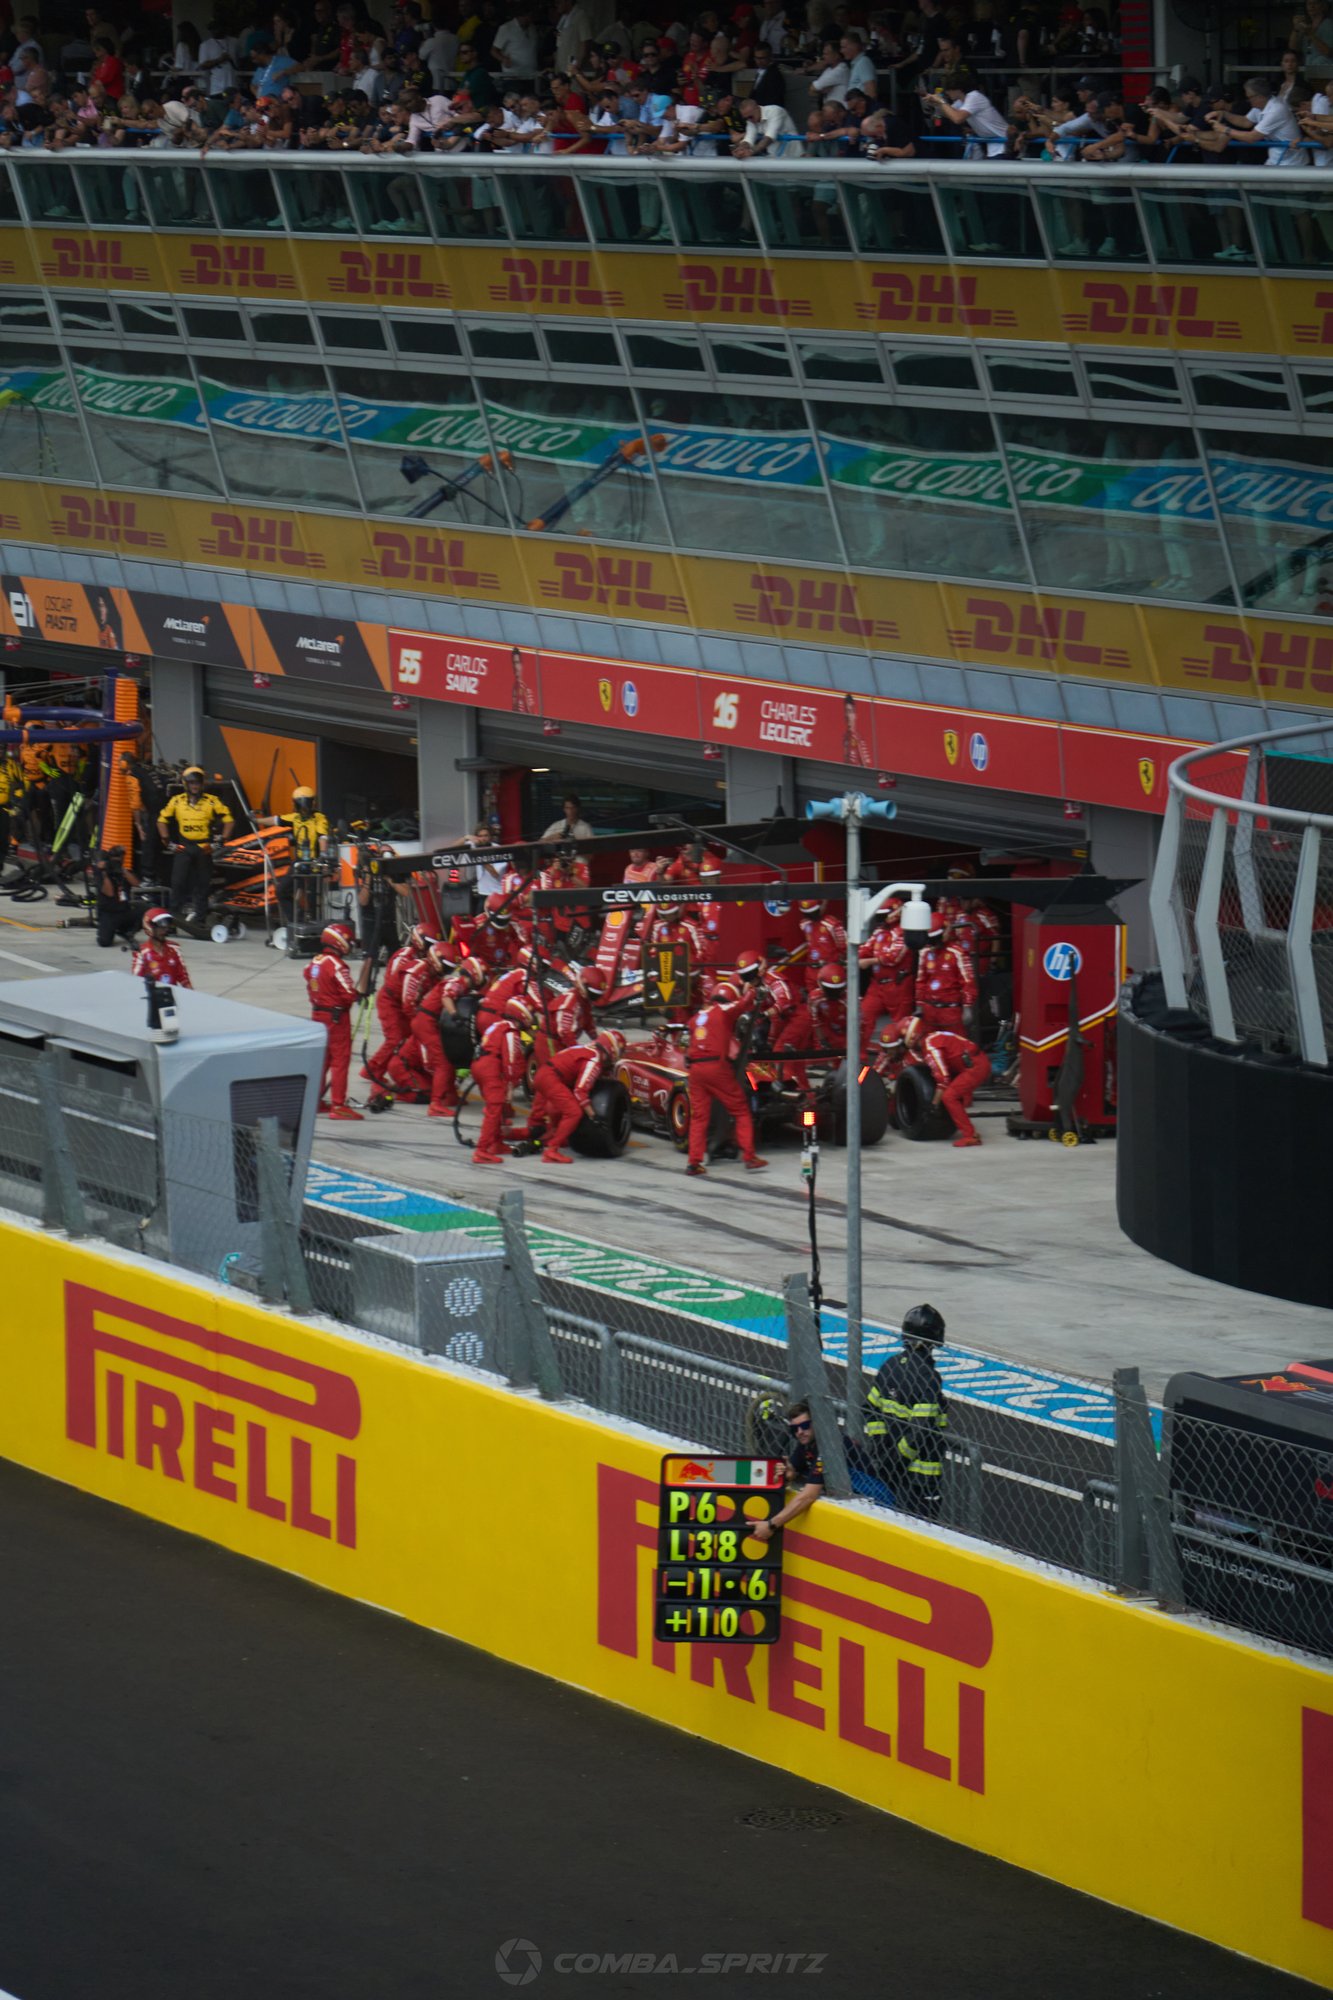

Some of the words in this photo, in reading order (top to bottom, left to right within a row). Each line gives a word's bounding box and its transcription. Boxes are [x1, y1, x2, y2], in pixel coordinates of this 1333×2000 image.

[52, 237, 134, 281] DHL
[190, 243, 277, 289] DHL
[340, 250, 436, 298] DHL
[501, 257, 603, 307] DHL
[678, 264, 792, 317] DHL
[871, 272, 992, 327] DHL
[1082, 281, 1215, 339] DHL
[61, 494, 149, 546] DHL
[210, 512, 307, 567] DHL
[373, 531, 478, 587] DHL
[554, 552, 668, 611] DHL
[45, 595, 73, 612] OSCAR
[46, 613, 77, 632] PIASTRI
[750, 573, 876, 639] DHL
[163, 617, 206, 634] McLaren
[296, 637, 341, 653] McLaren
[966, 598, 1102, 664] DHL
[398, 648, 423, 684] 55
[446, 653, 488, 676] CARLOS
[1203, 624, 1333, 693] DHL
[445, 674, 479, 695] SAINZ
[712, 692, 740, 730] 16
[760, 700, 818, 727] CHARLES
[759, 721, 813, 748] LECLERC
[432, 852, 472, 868] CEVA
[471, 852, 513, 864] LOGISTICS
[602, 890, 657, 903] CEVA
[657, 892, 713, 901] LOGISTICS
[1047, 943, 1077, 980] hp
[63, 1278, 362, 1551] PIRELLI
[670, 1530, 737, 1563] L38
[665, 1607, 738, 1638] +10
